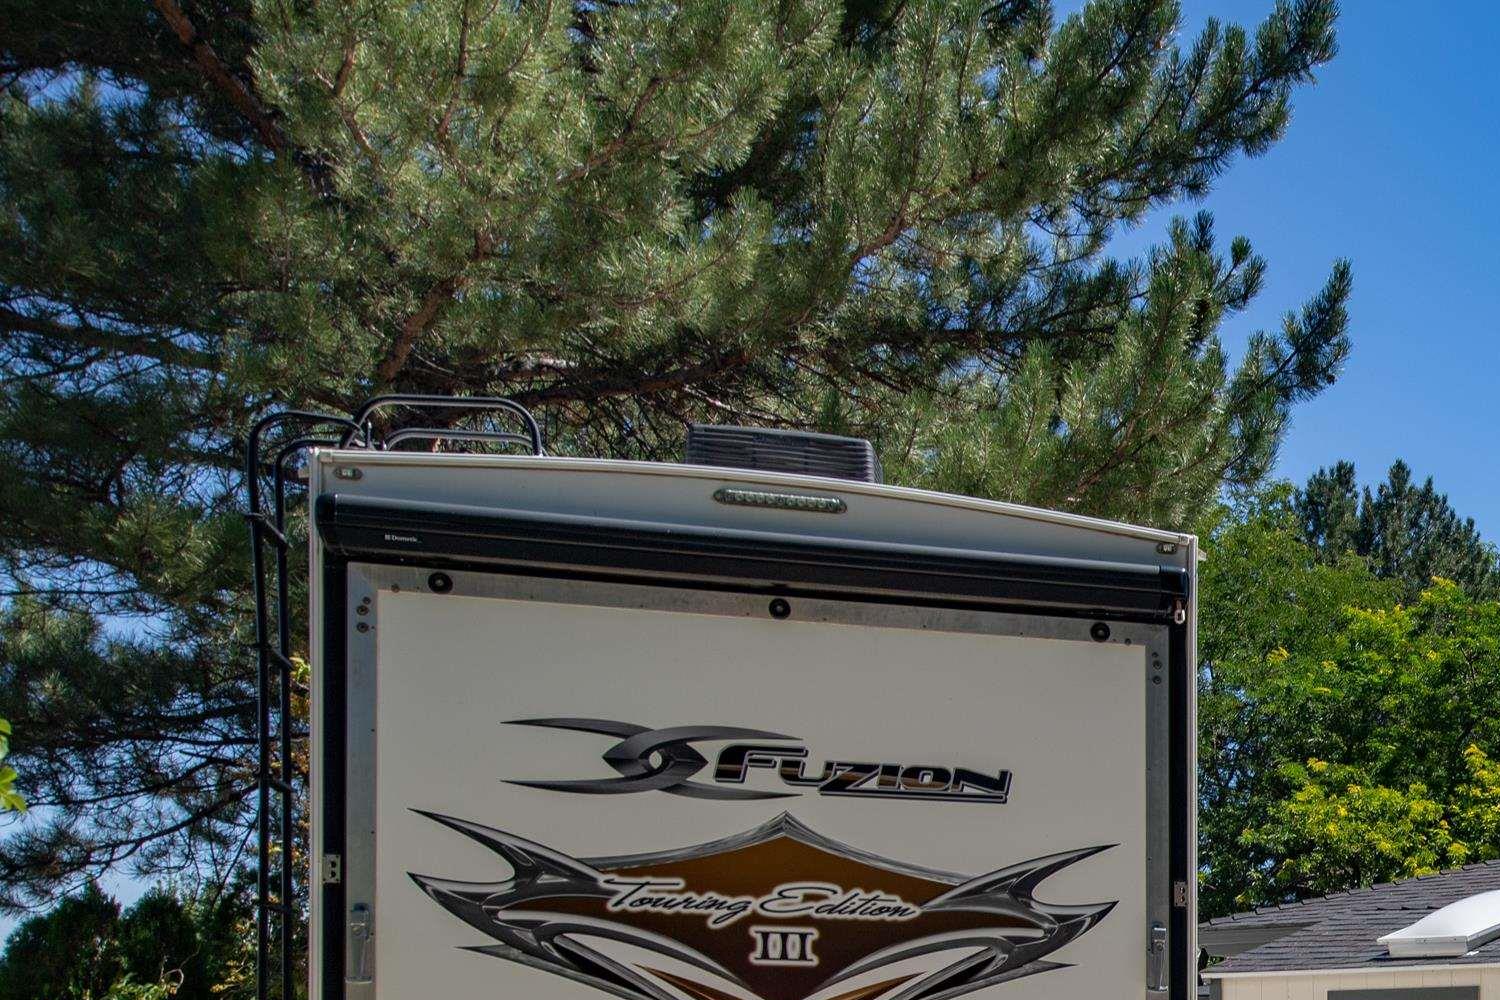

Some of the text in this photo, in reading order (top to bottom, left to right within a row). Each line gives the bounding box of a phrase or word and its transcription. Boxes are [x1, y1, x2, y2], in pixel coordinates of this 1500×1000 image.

[602, 877, 921, 925] Touring Edition
[753, 930, 815, 963] III
